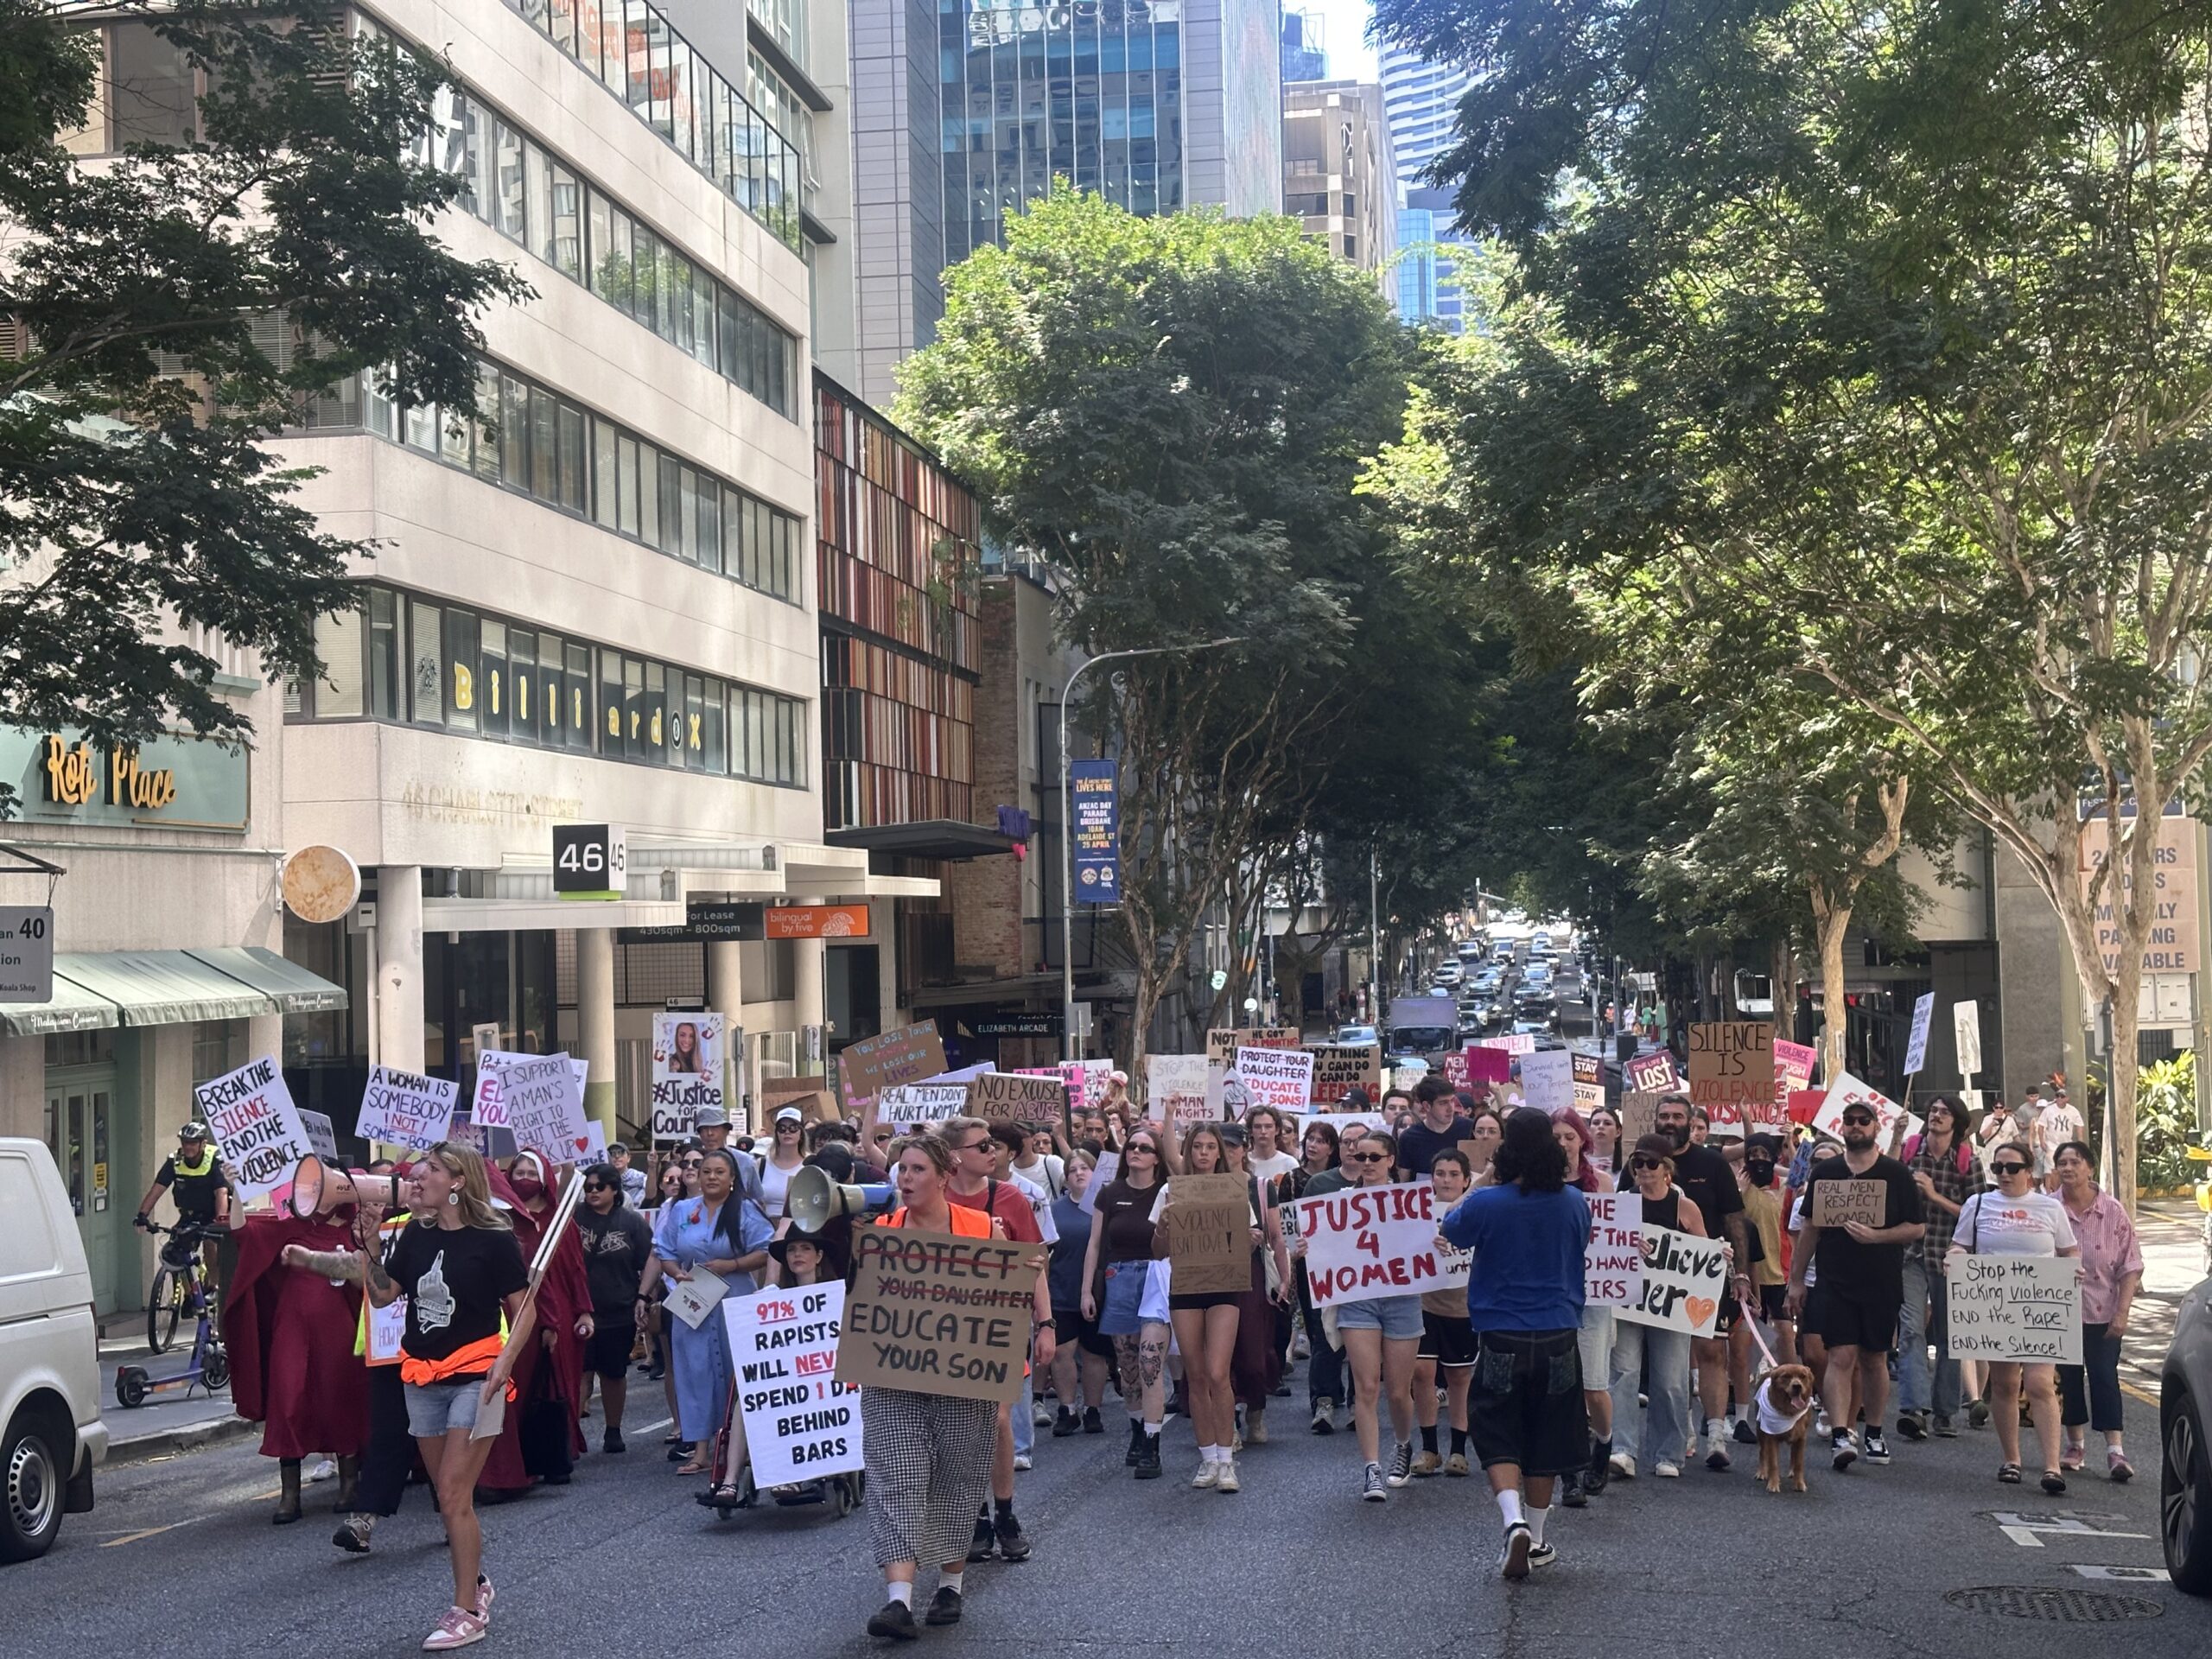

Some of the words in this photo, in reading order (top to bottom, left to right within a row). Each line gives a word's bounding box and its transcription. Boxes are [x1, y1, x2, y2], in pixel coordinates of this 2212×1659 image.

[48, 734, 97, 804] Roti
[112, 741, 177, 809] Place
[559, 843, 603, 872] 46
[611, 843, 625, 872] 46
[704, 910, 734, 920] Lease
[771, 912, 812, 924] bilingual
[19, 918, 45, 939] 40
[695, 925, 741, 935] 800sqm
[782, 925, 793, 933] by
[795, 924, 813, 932] five
[19, 983, 36, 993] Shop
[978, 1024, 1017, 1033] ELIZABETH
[1019, 1024, 1049, 1033] ARCADE
[1211, 1033, 1237, 1046] NOT
[1690, 1024, 1767, 1052] SILENCE
[855, 1043, 874, 1057] YOU
[878, 1033, 903, 1049] LOSE
[907, 1023, 933, 1039] YOUR
[908, 1049, 927, 1062] OUR
[1241, 1051, 1282, 1064] PROTECT
[1285, 1055, 1310, 1067] YOUR
[1446, 1056, 1465, 1068] MEN
[1778, 1044, 1809, 1061] VIOLENCE
[499, 1070, 512, 1091] I
[514, 1059, 567, 1084] SUPPORT
[885, 1065, 920, 1084] LIVES
[1242, 1064, 1306, 1079] DAUGHTER
[1328, 1062, 1352, 1071] CAN
[1355, 1061, 1369, 1070] DO
[1447, 1069, 1467, 1079] that
[1574, 1061, 1598, 1073] STAY
[1718, 1052, 1745, 1076] IS
[371, 1068, 383, 1084] A
[388, 1072, 429, 1094] WOMAN
[435, 1082, 448, 1097] IS
[1320, 1072, 1344, 1082] CAN
[1346, 1072, 1359, 1082] DO
[198, 1071, 252, 1118] BREAK
[247, 1059, 275, 1091] THE
[509, 1095, 520, 1112] A
[521, 1080, 564, 1109] MAN'S
[652, 1080, 722, 1106] #Justice
[881, 1087, 910, 1103] REAL
[913, 1087, 938, 1103] MEN
[977, 1077, 1005, 1100] NO
[1008, 1078, 1060, 1101] EXCUSE
[1574, 1089, 1596, 1100] STAY
[1690, 1079, 1774, 1104] VIOLENCE
[368, 1087, 451, 1123] SOMEBODY
[677, 1103, 694, 1116] for
[888, 1105, 924, 1122] HURT
[983, 1101, 1009, 1118] FOR
[1014, 1101, 1060, 1121] ABUSE
[1175, 1109, 1214, 1118] RIGHTS
[512, 1108, 544, 1131] RIGHT
[549, 1105, 564, 1119] TO
[221, 1124, 258, 1160] END
[254, 1113, 287, 1145] THE
[362, 1123, 394, 1144] SOME
[518, 1126, 544, 1147] SHUT
[549, 1117, 573, 1139] THE
[558, 1140, 575, 1159] UP
[238, 1141, 304, 1186] VIOLENCE
[1817, 1182, 1843, 1195] REAL
[1849, 1182, 1875, 1194] MEN
[1300, 1187, 1433, 1238] JUSTICE
[1824, 1194, 1882, 1209] RESPECT
[1824, 1212, 1876, 1226] WOMEN
[1357, 1230, 1380, 1258] 4
[1605, 1229, 1639, 1247] THE
[860, 1233, 1020, 1280] PROTECT
[1597, 1255, 1638, 1272] HAVE
[1309, 1252, 1438, 1303] WOMEN
[1966, 1259, 2006, 1282] Stop
[2011, 1262, 2038, 1279] the
[877, 1274, 926, 1302] YOUR
[931, 1284, 1037, 1310] DAUGHTER
[1951, 1282, 2003, 1311] Fucking
[756, 1300, 795, 1321] 97%
[803, 1294, 826, 1313] OF
[1952, 1310, 1980, 1325] END
[1987, 1310, 2015, 1325] the
[850, 1302, 1013, 1347] EDUCATE
[755, 1321, 841, 1351] RAPISTS
[1952, 1336, 1979, 1349] END
[1980, 1334, 2004, 1351] the
[741, 1359, 789, 1382] WILL
[873, 1342, 940, 1374] YOUR
[947, 1352, 1007, 1384] SON
[744, 1385, 810, 1413] SPEND
[817, 1382, 824, 1400] 1
[778, 1407, 850, 1437] BEHIND
[791, 1439, 848, 1465] BARS
